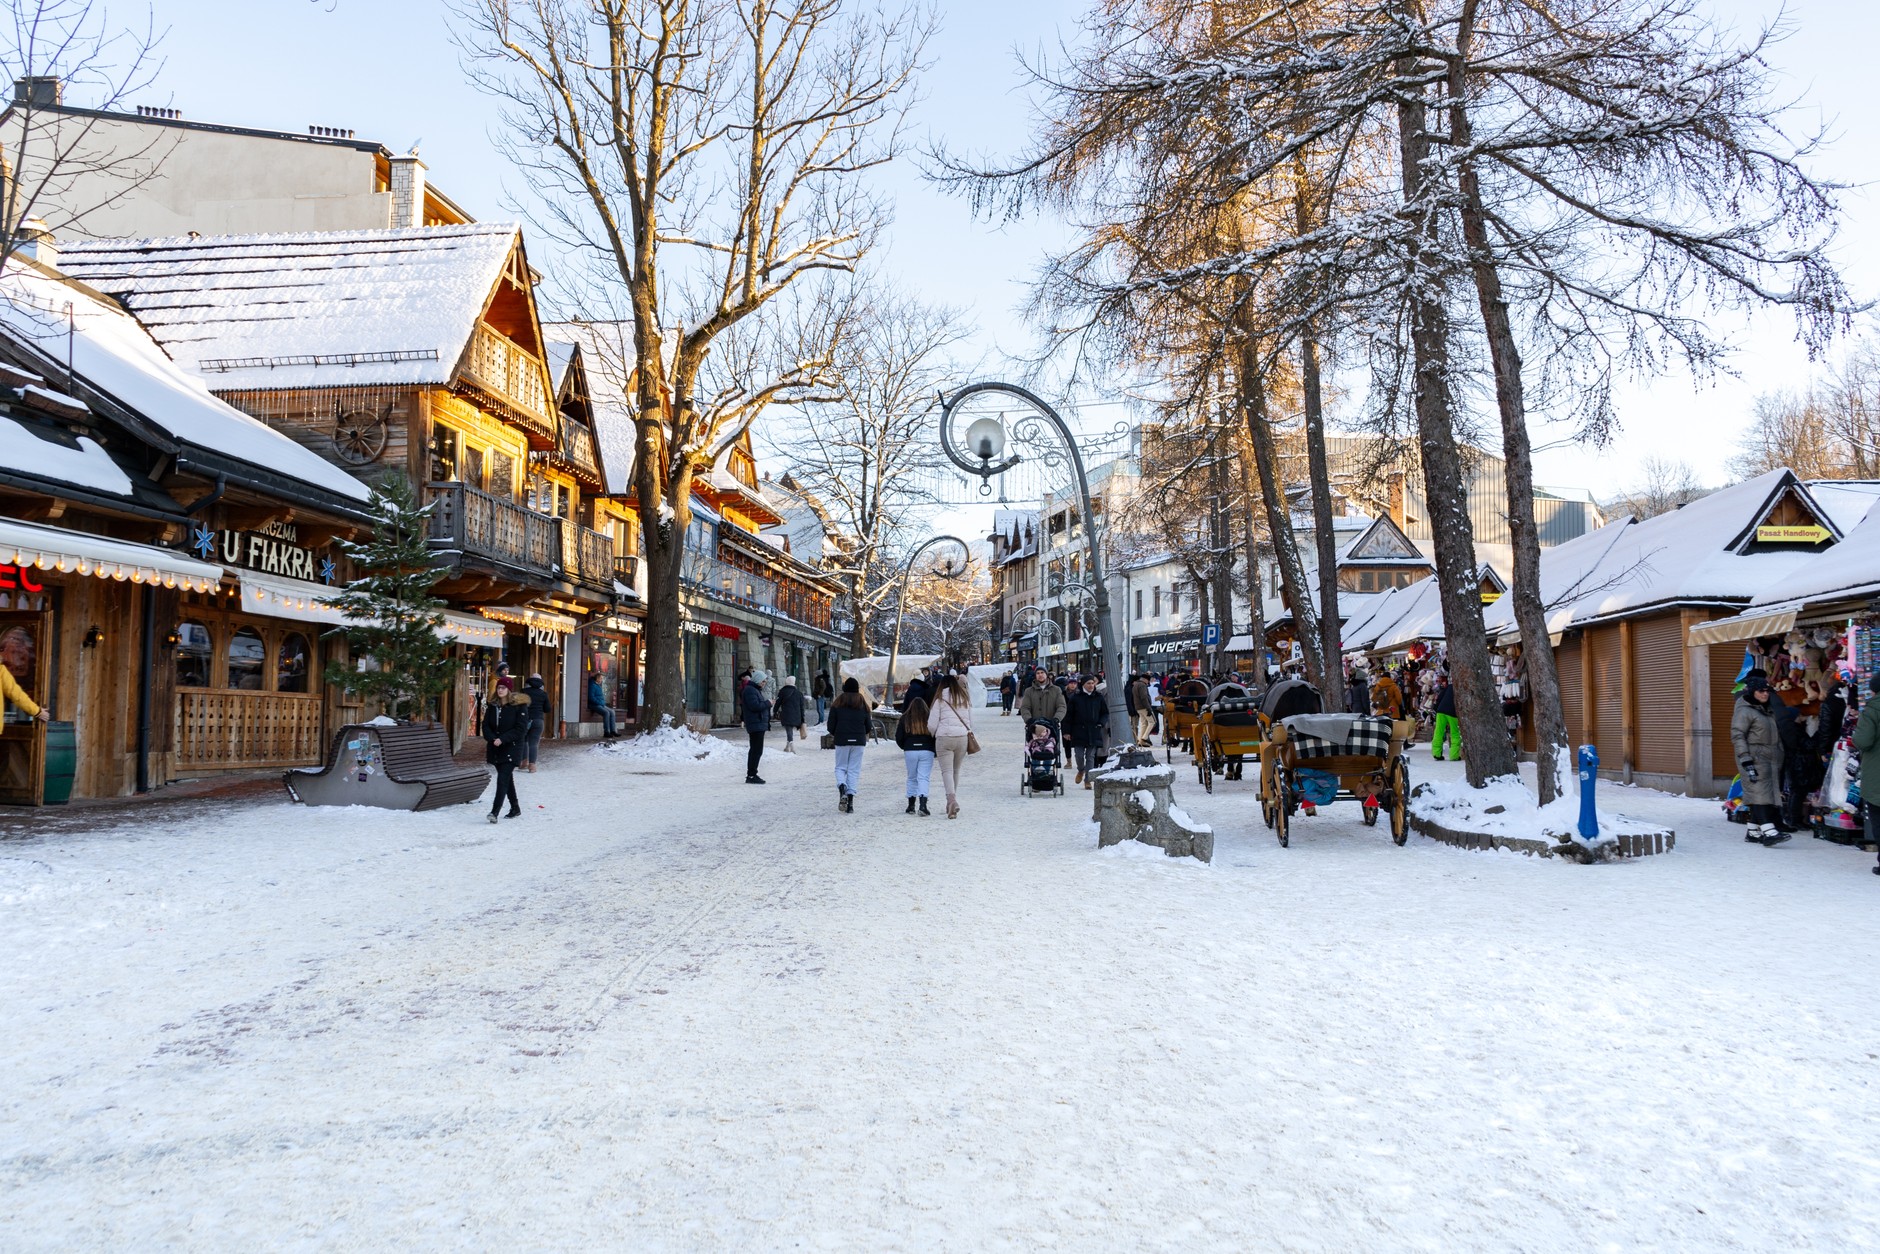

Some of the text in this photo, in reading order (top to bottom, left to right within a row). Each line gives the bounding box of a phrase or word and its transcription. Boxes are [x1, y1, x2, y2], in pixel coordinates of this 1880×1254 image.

[1759, 529, 1821, 539] Pasaż Handlowy
[223, 529, 314, 580] U FIAKRA
[528, 625, 559, 648] PIZZA
[1206, 626, 1217, 643] P
